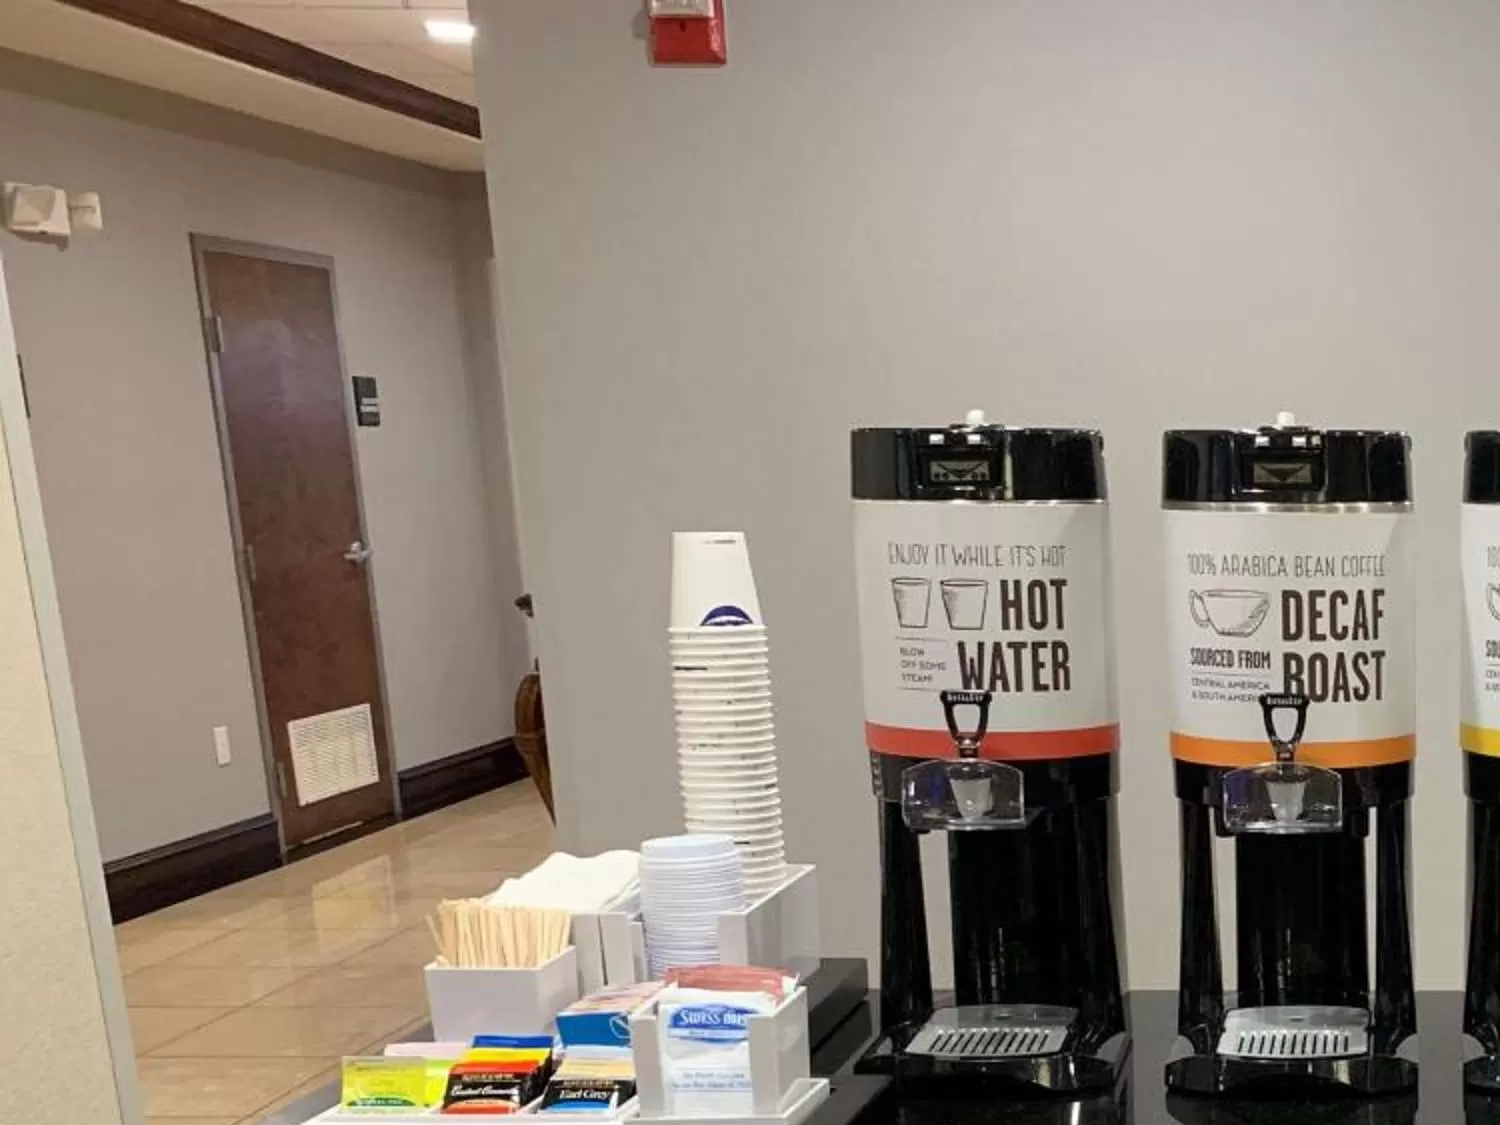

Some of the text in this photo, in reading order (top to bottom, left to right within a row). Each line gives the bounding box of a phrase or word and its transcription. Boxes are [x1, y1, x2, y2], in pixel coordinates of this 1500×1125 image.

[888, 542, 1068, 567] ENJOY IT WHILE IT'S HOT
[1188, 552, 1386, 578] 100% ARABICA BEAN COFFEE
[1000, 579, 1068, 631] HOT
[1281, 588, 1386, 642] DECAF
[957, 640, 1071, 692] WATER
[1190, 647, 1271, 669] SOURCED FROM
[1282, 650, 1387, 703] ROAST
[1228, 680, 1270, 690] AMERICA
